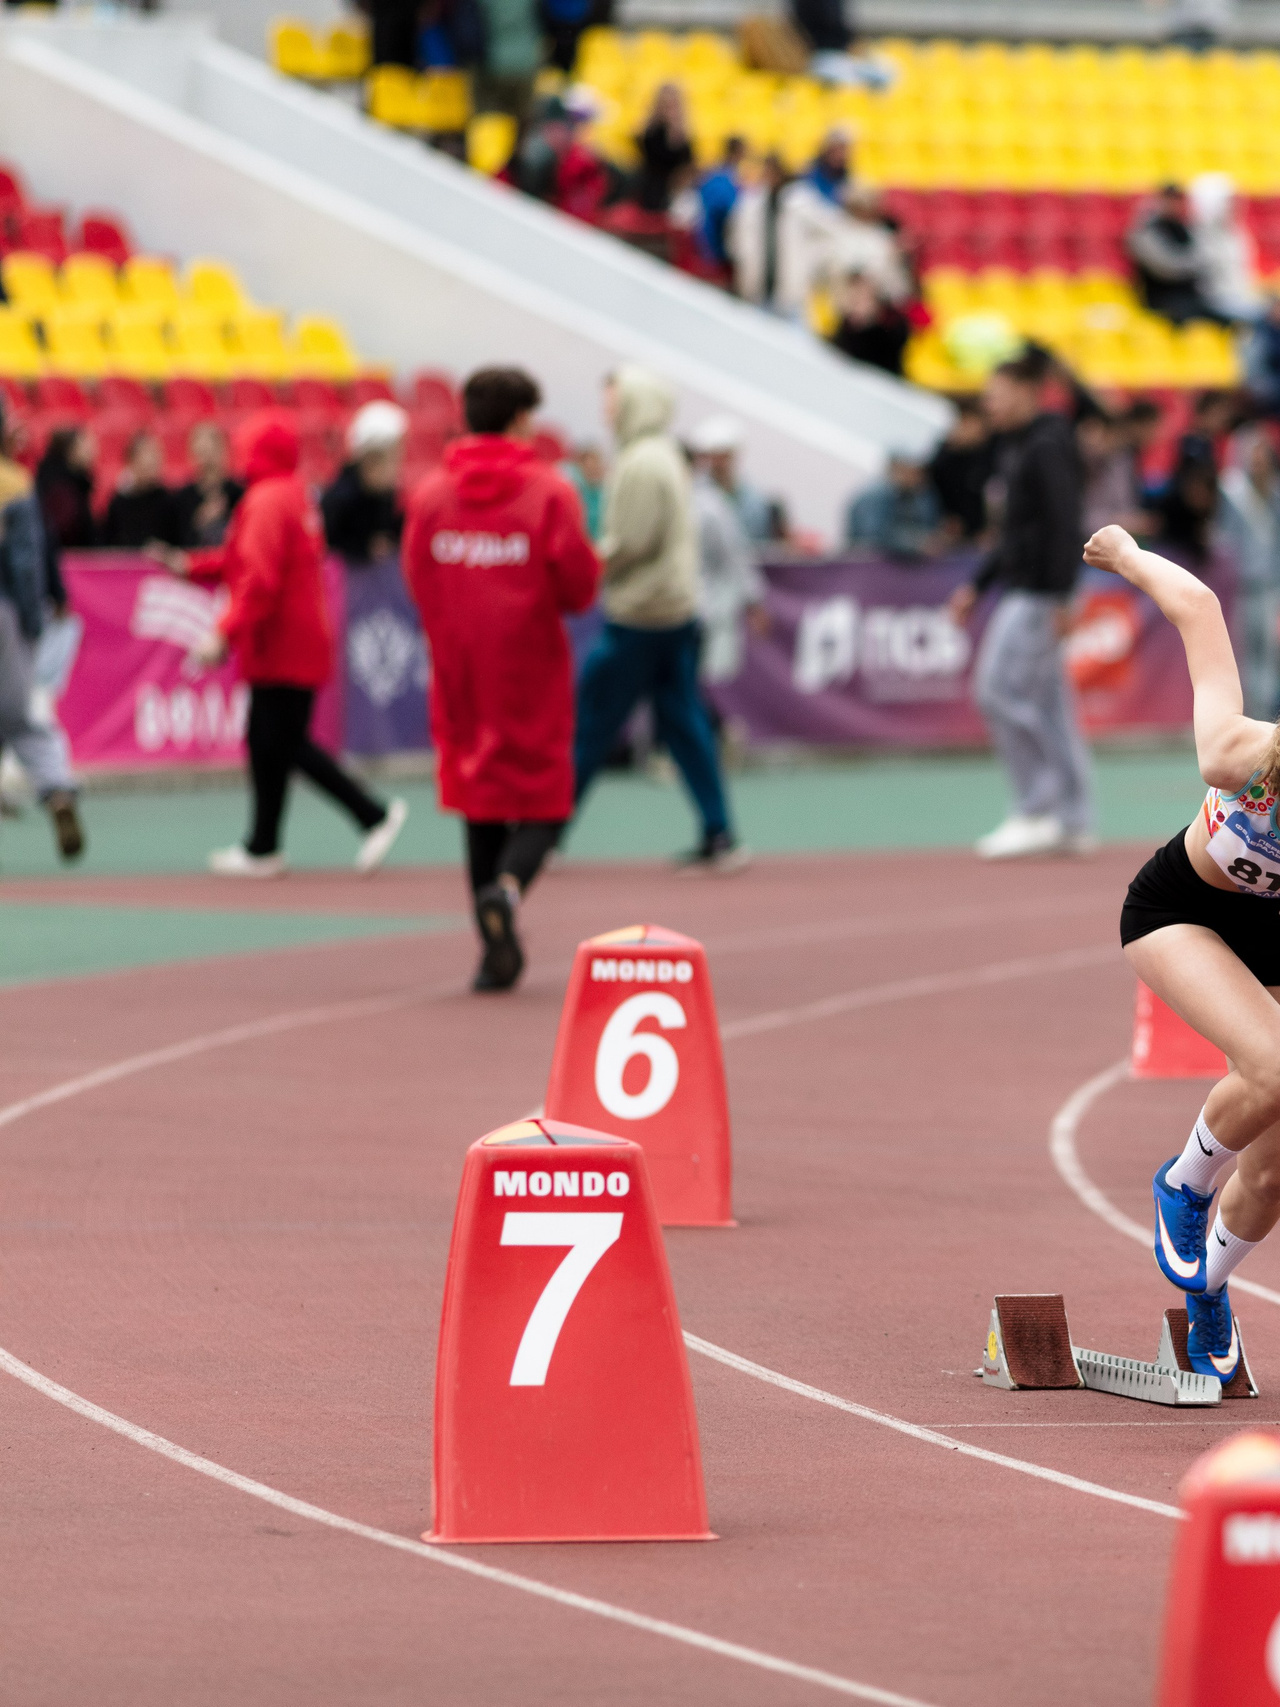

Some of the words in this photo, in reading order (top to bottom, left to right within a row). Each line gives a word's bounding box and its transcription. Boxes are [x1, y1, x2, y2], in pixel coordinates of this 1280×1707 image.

[591, 958, 693, 983] MONDO
[594, 990, 687, 1120] 6
[493, 1171, 630, 1197] MONDO
[500, 1212, 624, 1386] 7
